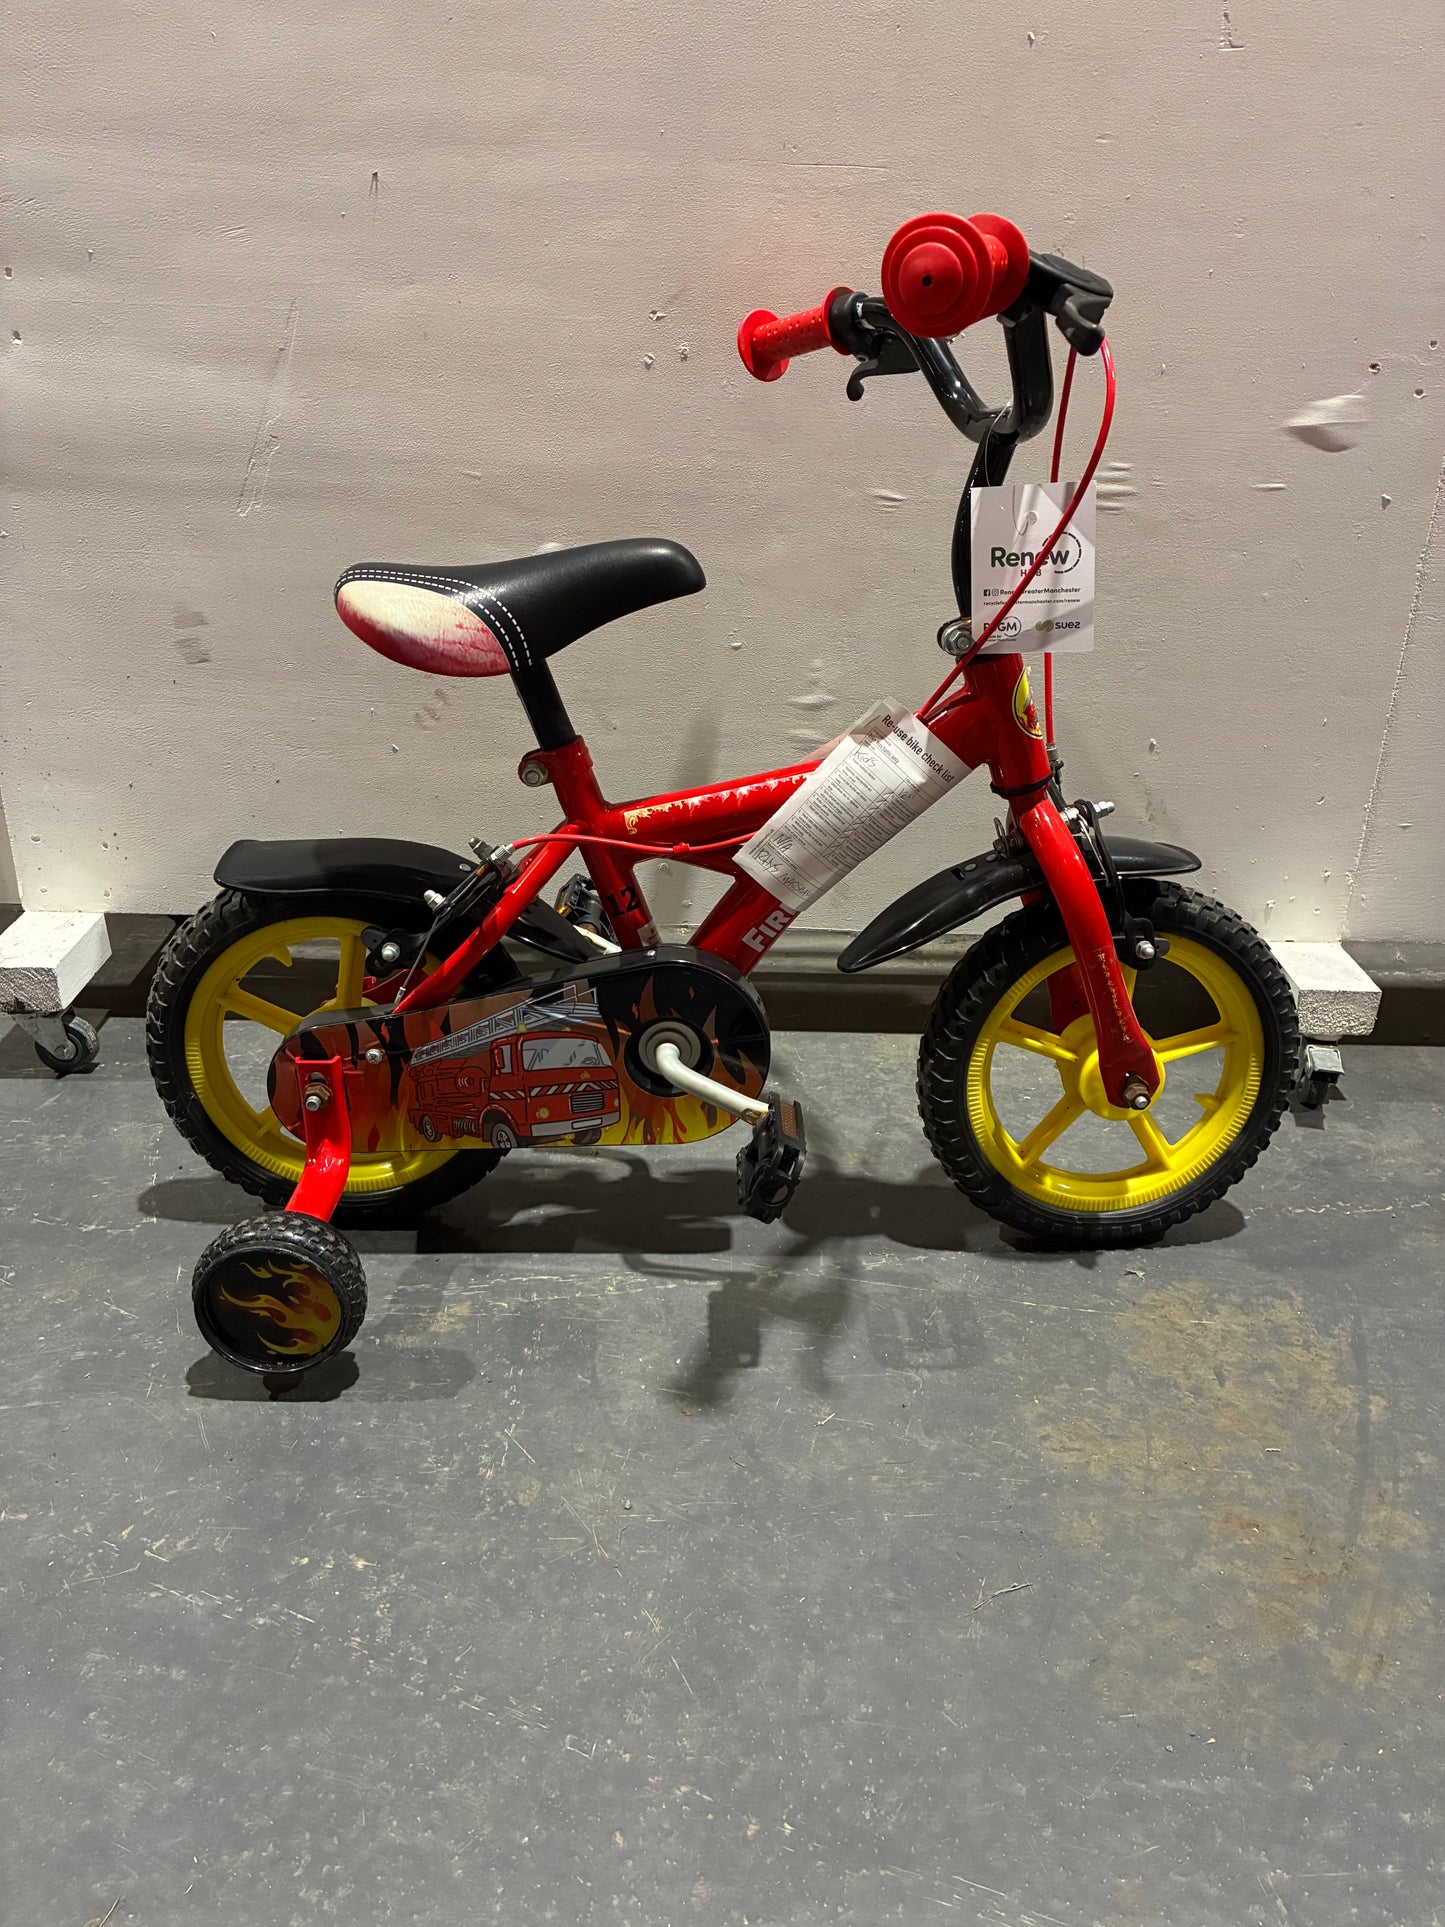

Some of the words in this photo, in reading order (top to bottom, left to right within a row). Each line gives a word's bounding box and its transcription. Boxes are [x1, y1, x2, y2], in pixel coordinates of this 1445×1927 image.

[1020, 569, 1042, 577] HB
[881, 714, 908, 741] Re-use
[905, 736, 924, 755] bike
[920, 751, 945, 775] check
[940, 769, 955, 784] list
[772, 833, 793, 853] N/A
[607, 886, 641, 917] 12
[741, 902, 797, 953] FIR
